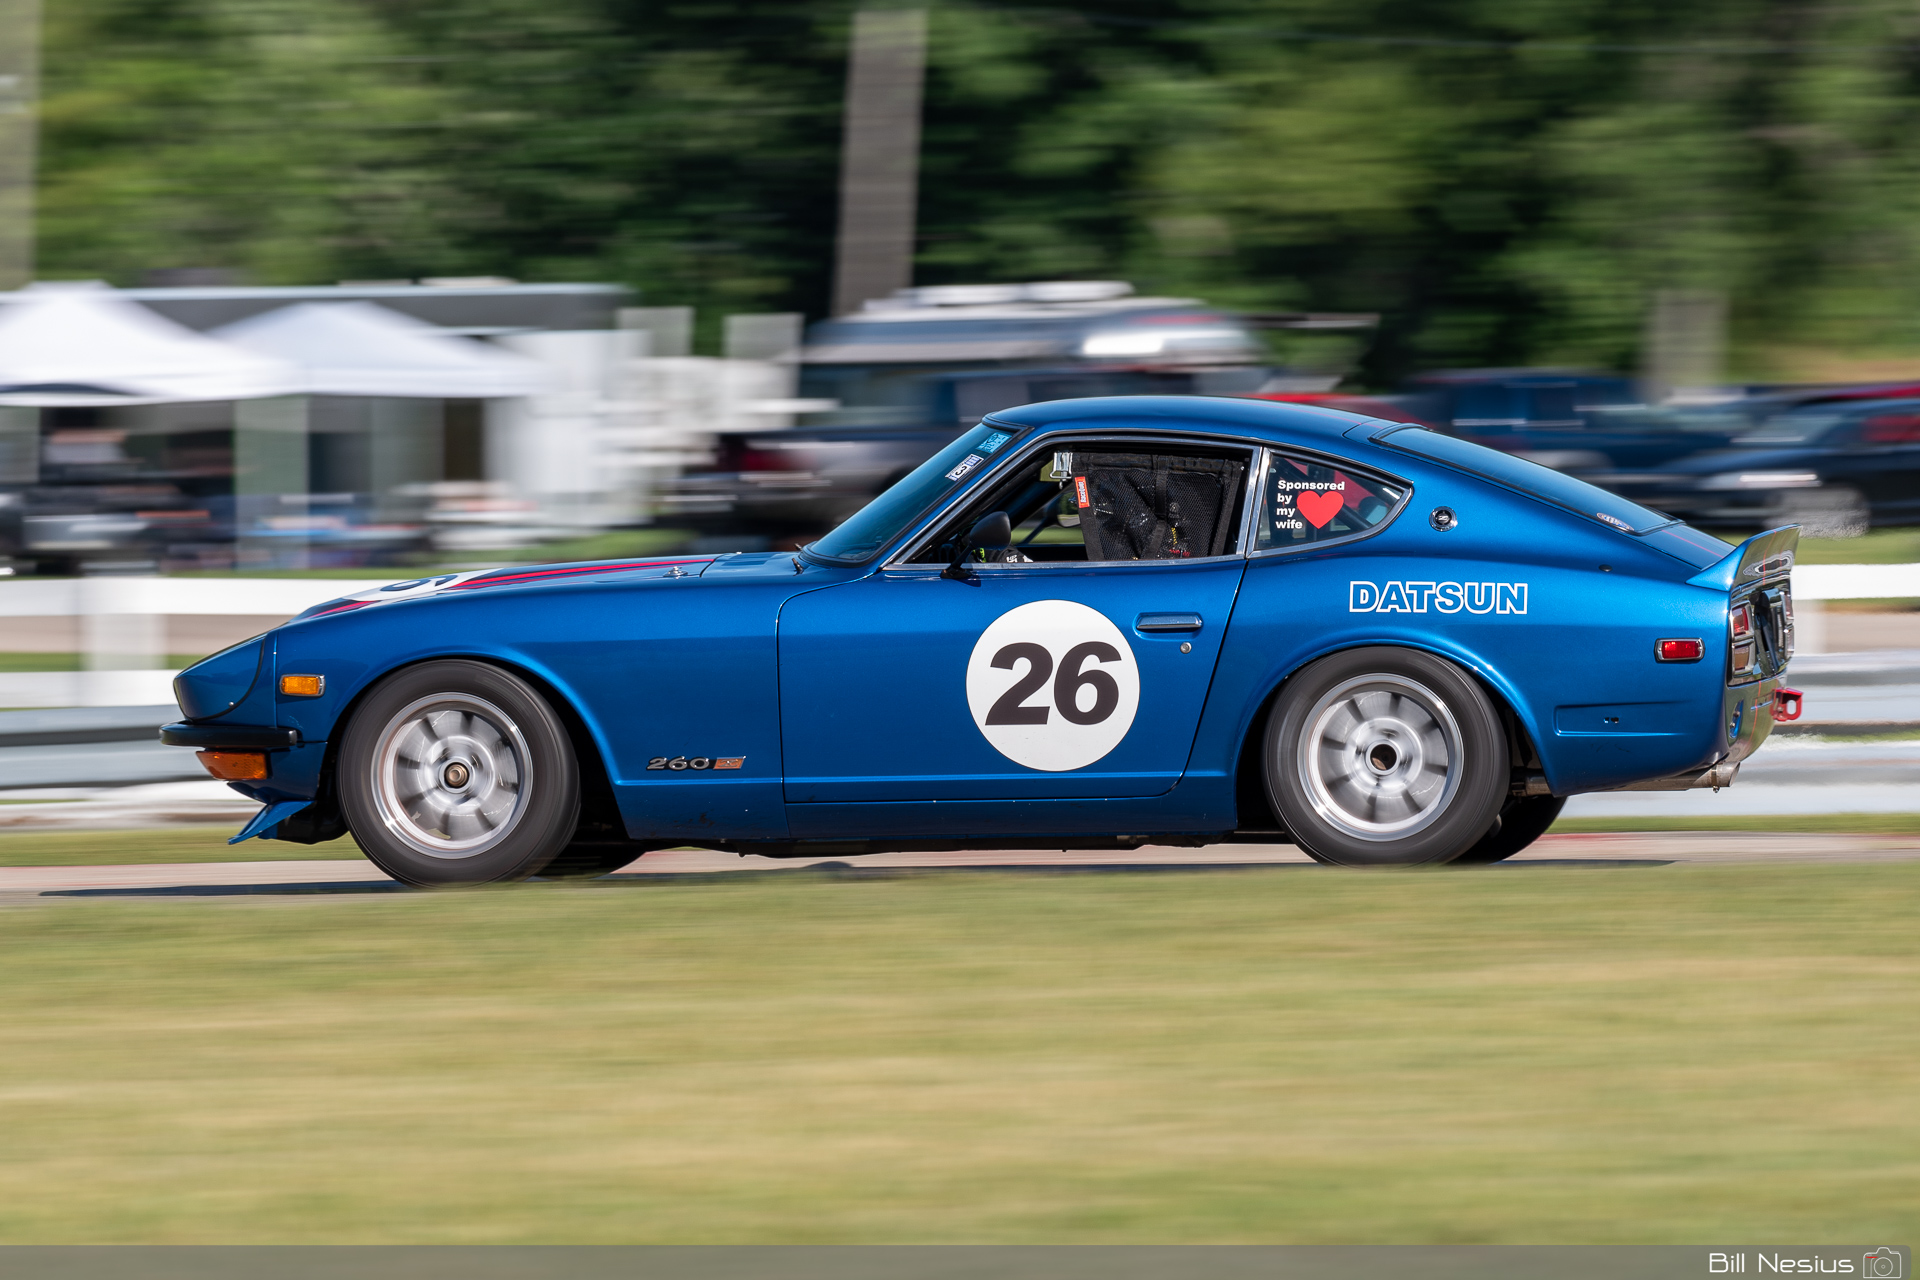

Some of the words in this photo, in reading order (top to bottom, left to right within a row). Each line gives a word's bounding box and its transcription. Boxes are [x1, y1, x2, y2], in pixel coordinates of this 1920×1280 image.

[1278, 480, 1345, 491] Sponsored
[1277, 493, 1292, 504] by
[1276, 507, 1295, 517] my
[1275, 519, 1303, 529] wife
[1349, 581, 1528, 614] DATSUN
[985, 641, 1122, 726] 26
